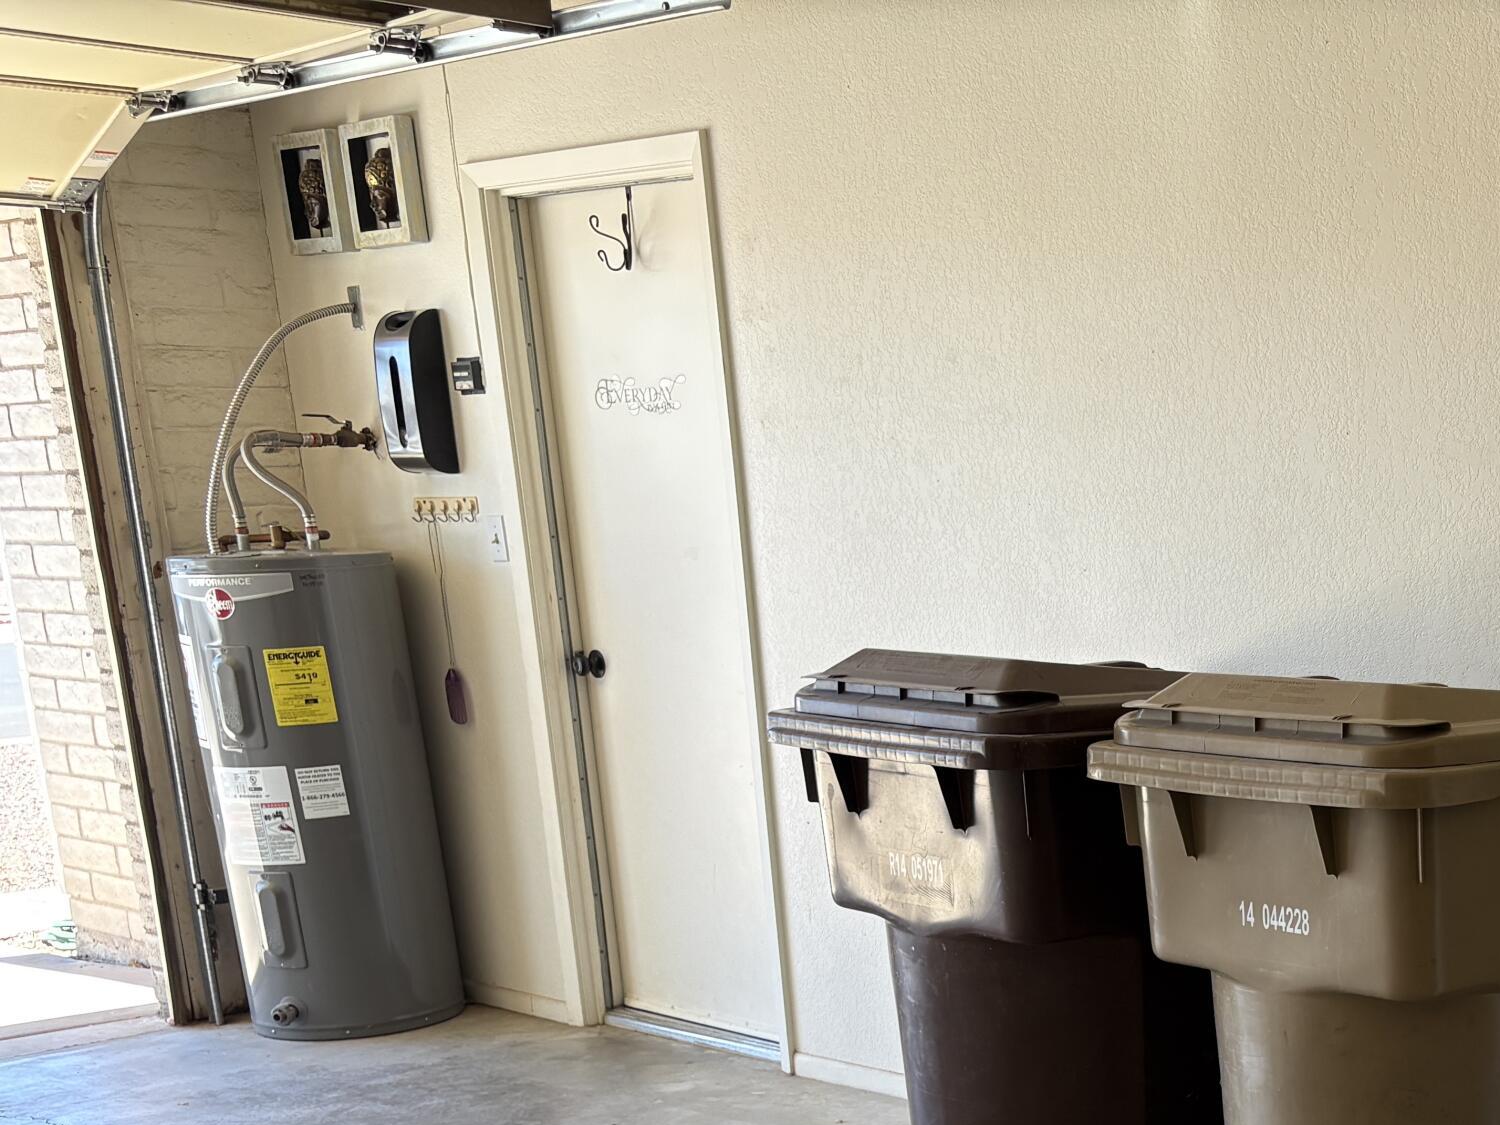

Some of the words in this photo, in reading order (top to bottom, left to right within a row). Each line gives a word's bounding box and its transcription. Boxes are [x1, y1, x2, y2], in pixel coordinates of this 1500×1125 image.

[188, 577, 252, 587] PERFORMANCE
[888, 851, 907, 877] R14
[911, 855, 944, 888] 051971
[1239, 900, 1255, 928] 14
[1262, 903, 1310, 936] 044228
